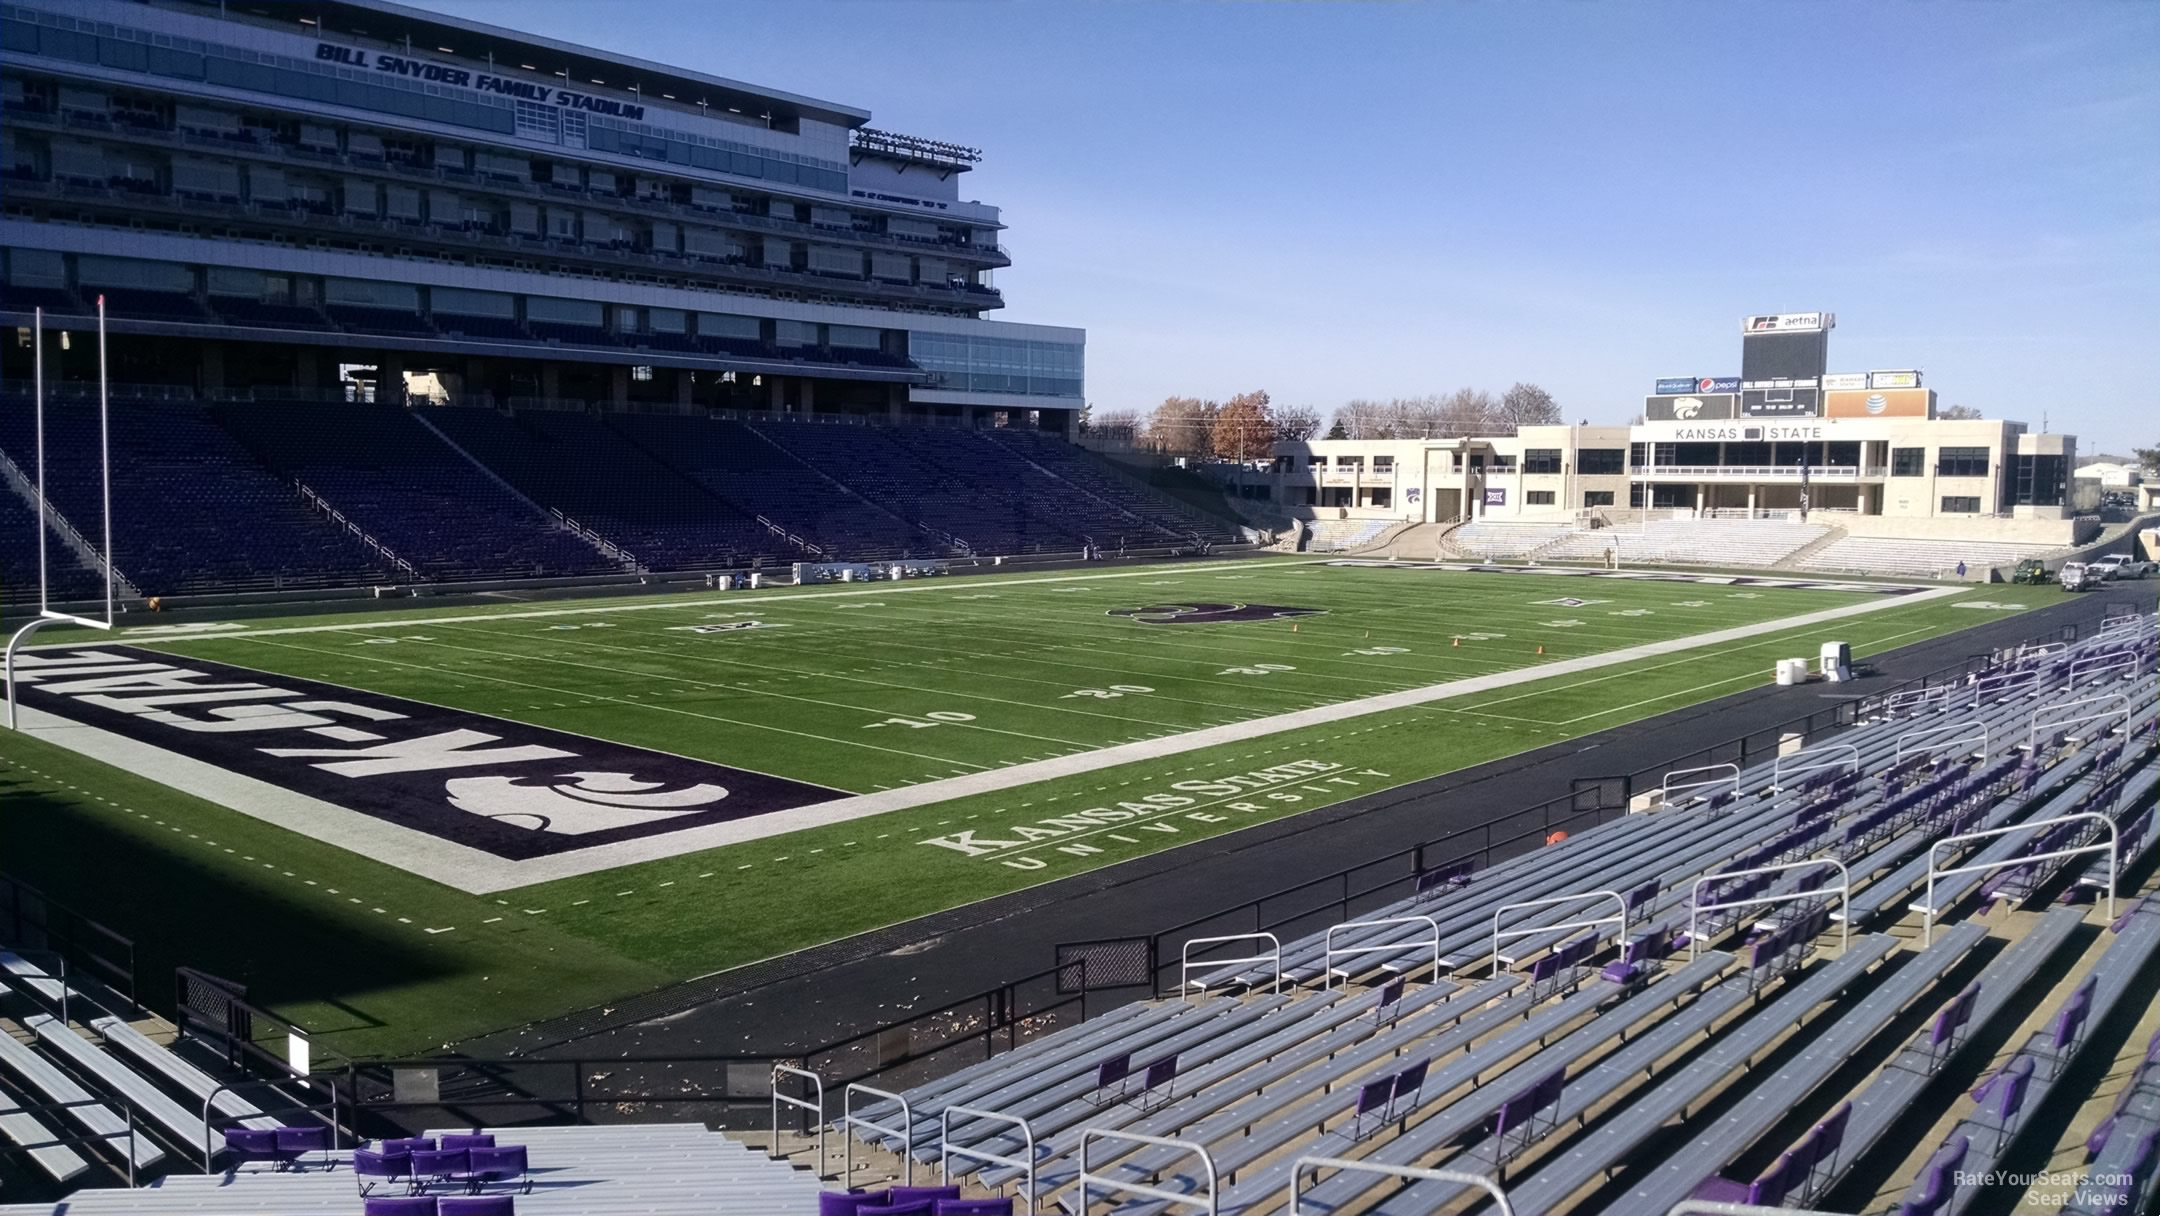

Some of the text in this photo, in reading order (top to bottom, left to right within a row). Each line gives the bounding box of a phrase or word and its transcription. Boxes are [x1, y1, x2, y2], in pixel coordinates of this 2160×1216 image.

[315, 42, 645, 121] BILL SNYDER FAMILY STADIUM
[1785, 316, 1817, 326] aetna
[1715, 381, 1738, 390] pepsi
[1675, 427, 1821, 440] KANSAS STATE
[1226, 663, 1296, 675] 30
[1073, 685, 1155, 699] 20
[883, 711, 977, 729] 10
[1000, 768, 1391, 870] UNIVERSITY
